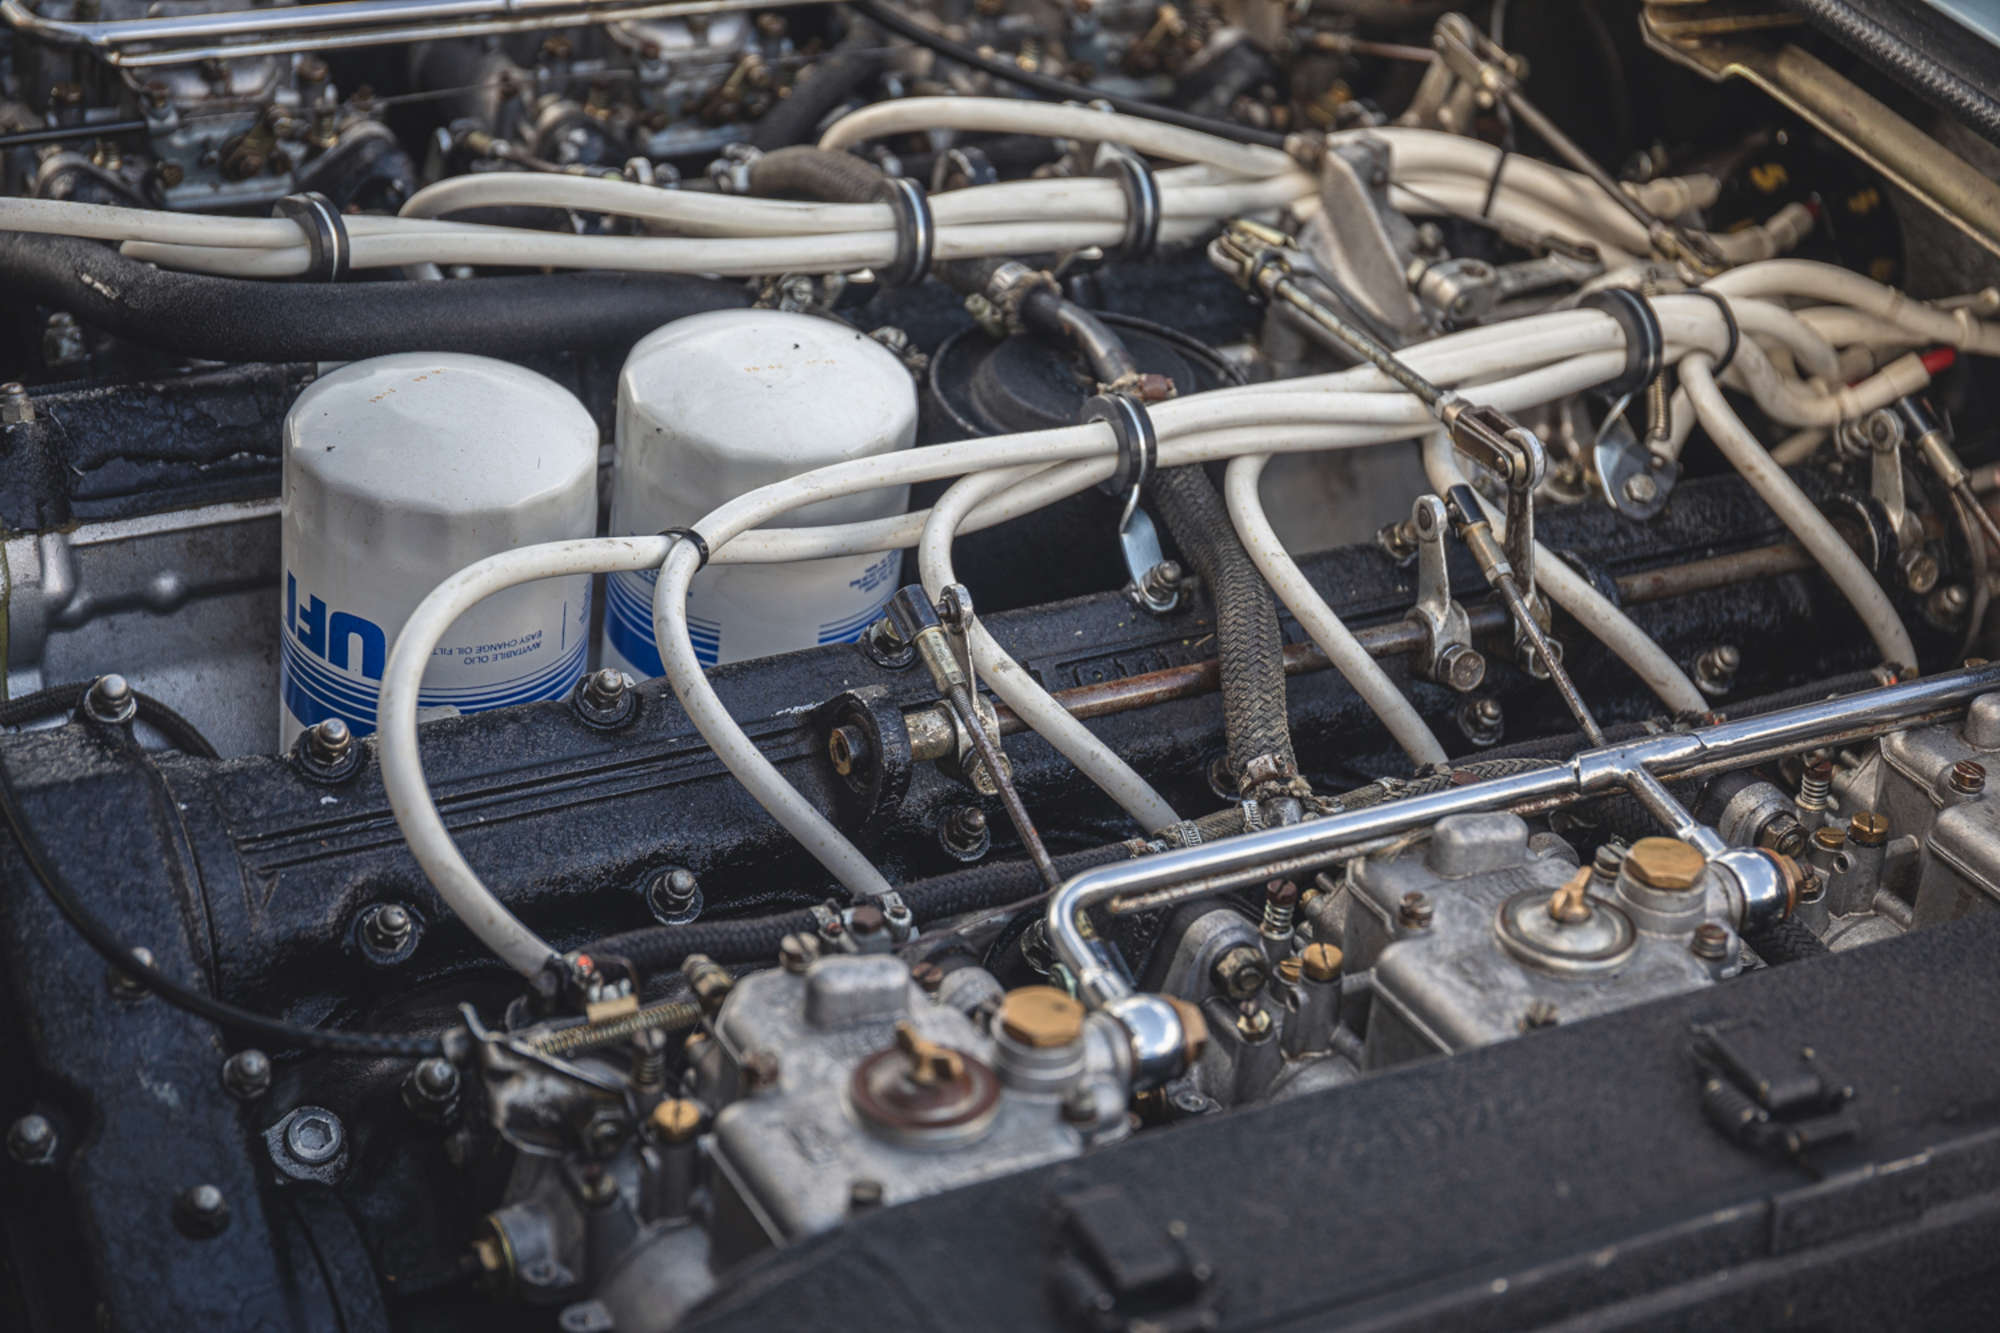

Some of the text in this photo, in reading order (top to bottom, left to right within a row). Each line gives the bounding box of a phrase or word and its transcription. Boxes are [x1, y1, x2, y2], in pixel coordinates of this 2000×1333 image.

[287, 569, 386, 681] UFI
[432, 630, 543, 656] EASY CHANGE OIL FILT
[463, 640, 542, 665] AVVITABILE OLIO
